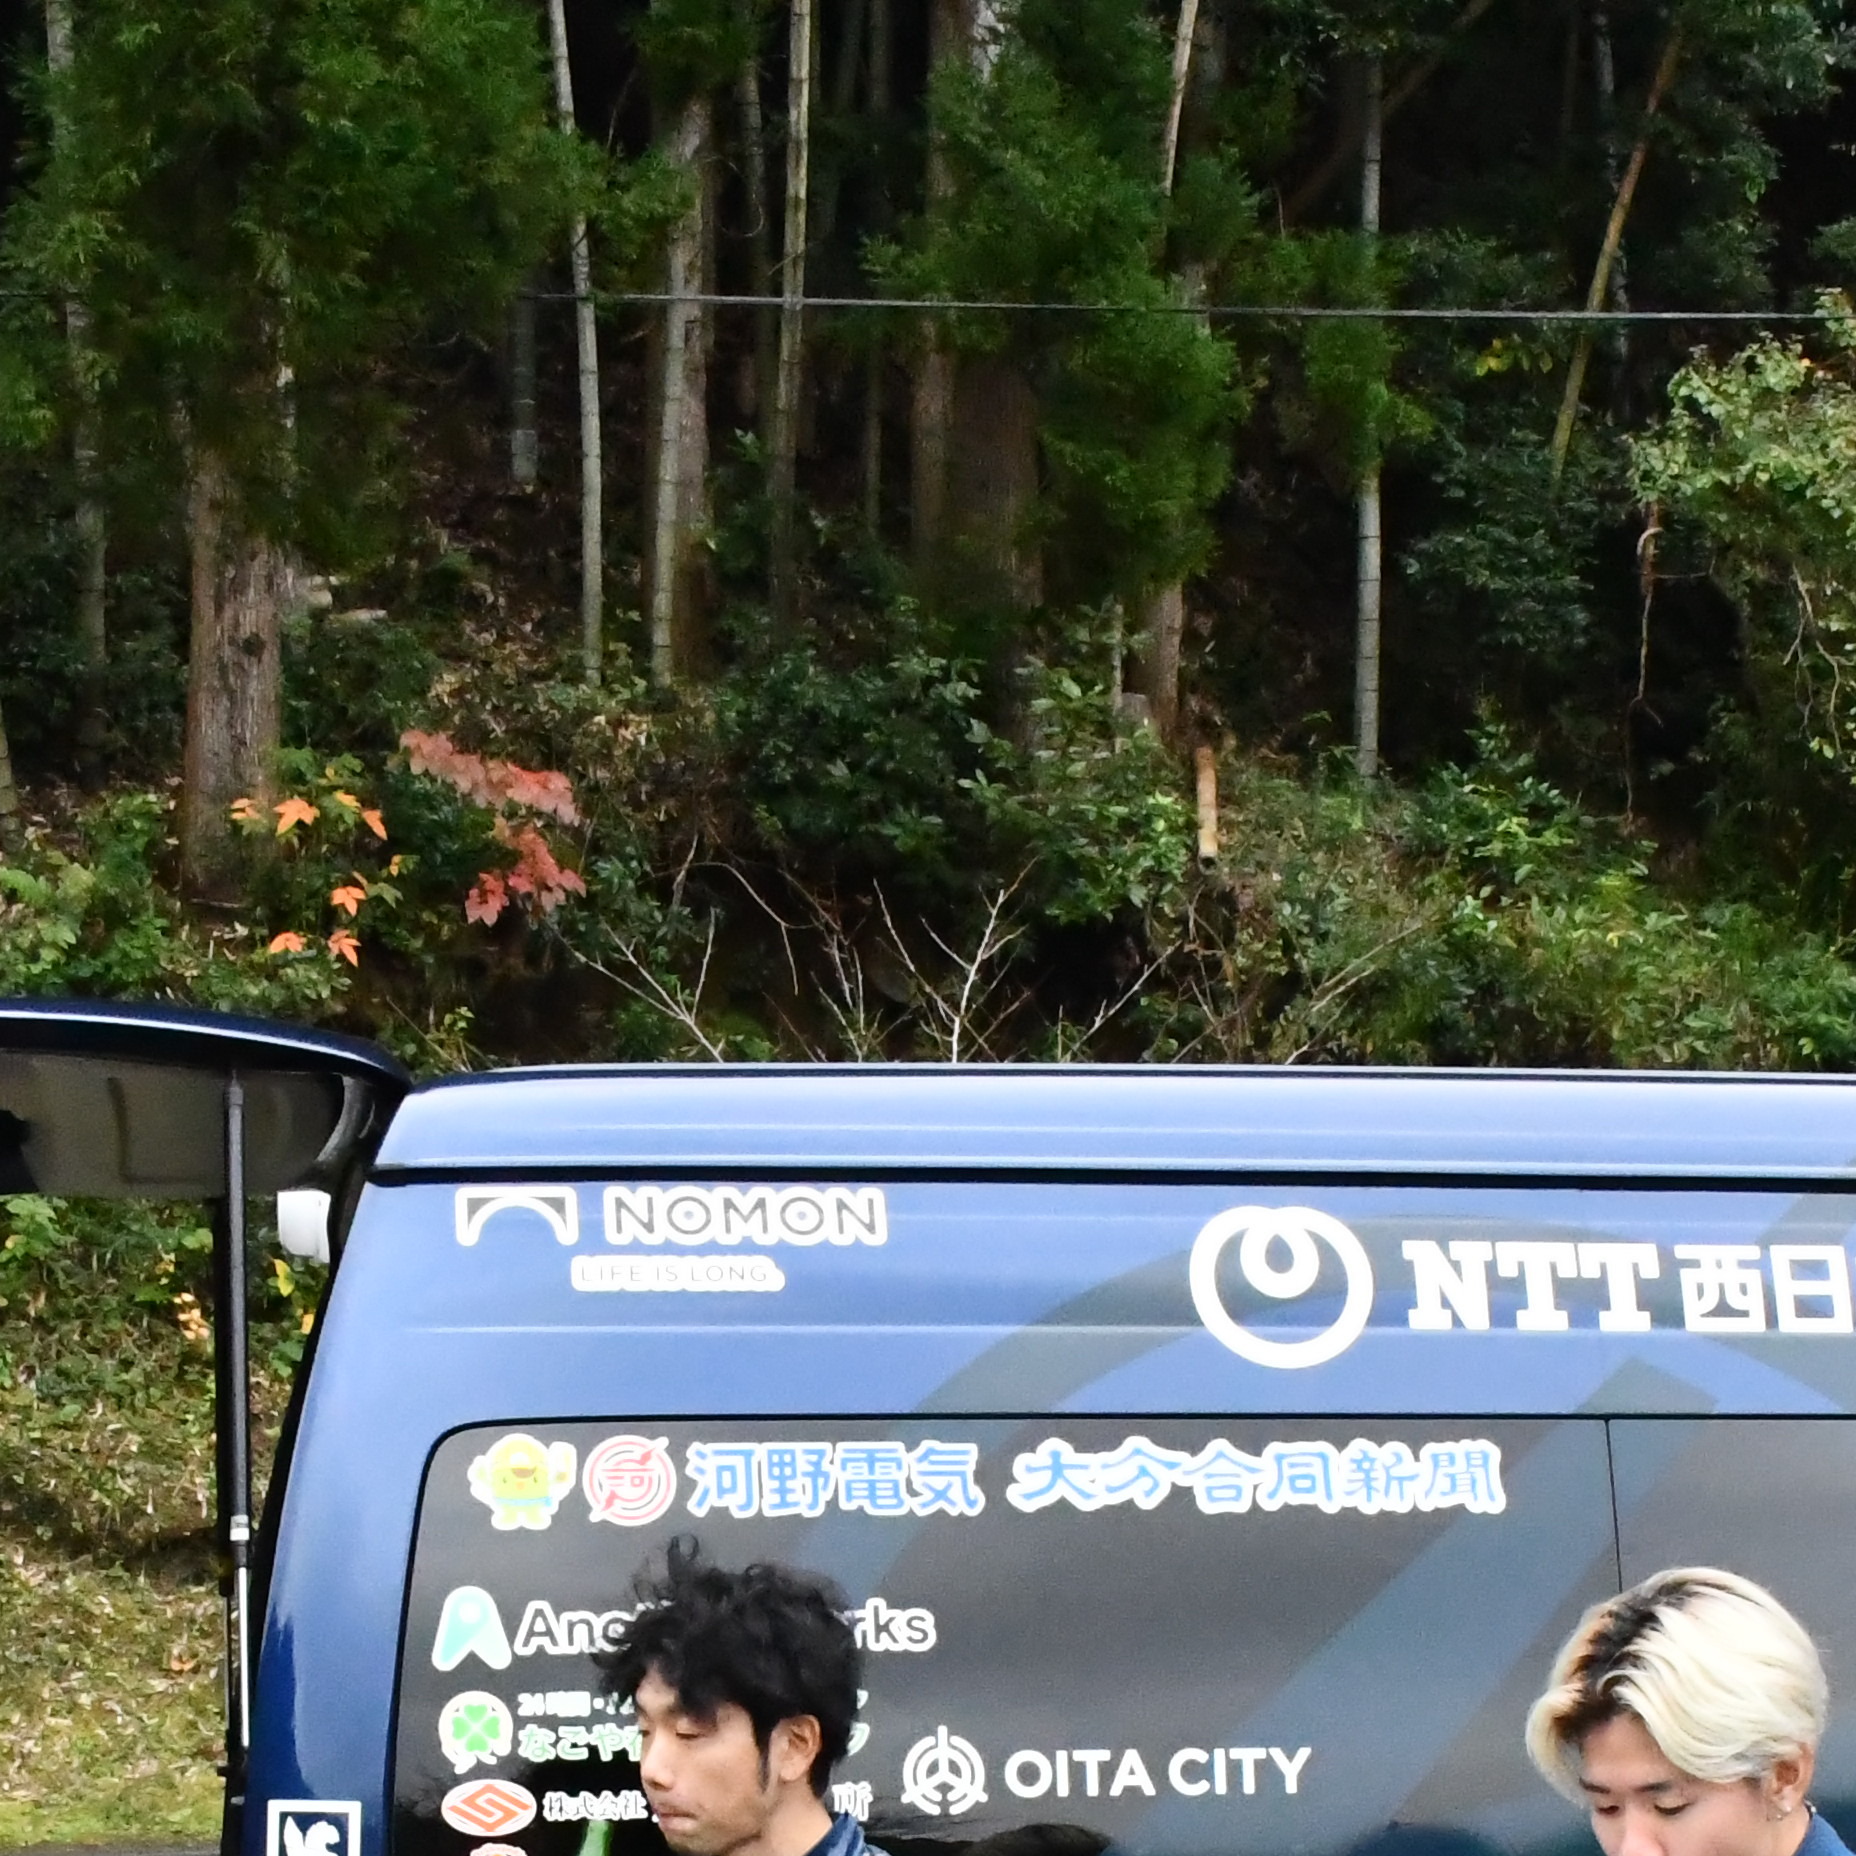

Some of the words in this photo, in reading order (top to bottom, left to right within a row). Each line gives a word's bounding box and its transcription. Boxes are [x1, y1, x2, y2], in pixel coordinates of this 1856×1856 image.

[614, 1195, 878, 1236] NOMON
[580, 1263, 642, 1283] LIFE
[655, 1263, 679, 1283] IS
[690, 1263, 768, 1283] LONG
[692, 1445, 980, 1512] 河野電気
[1004, 1747, 1157, 1799] OITA
[1168, 1746, 1312, 1796] CITY
